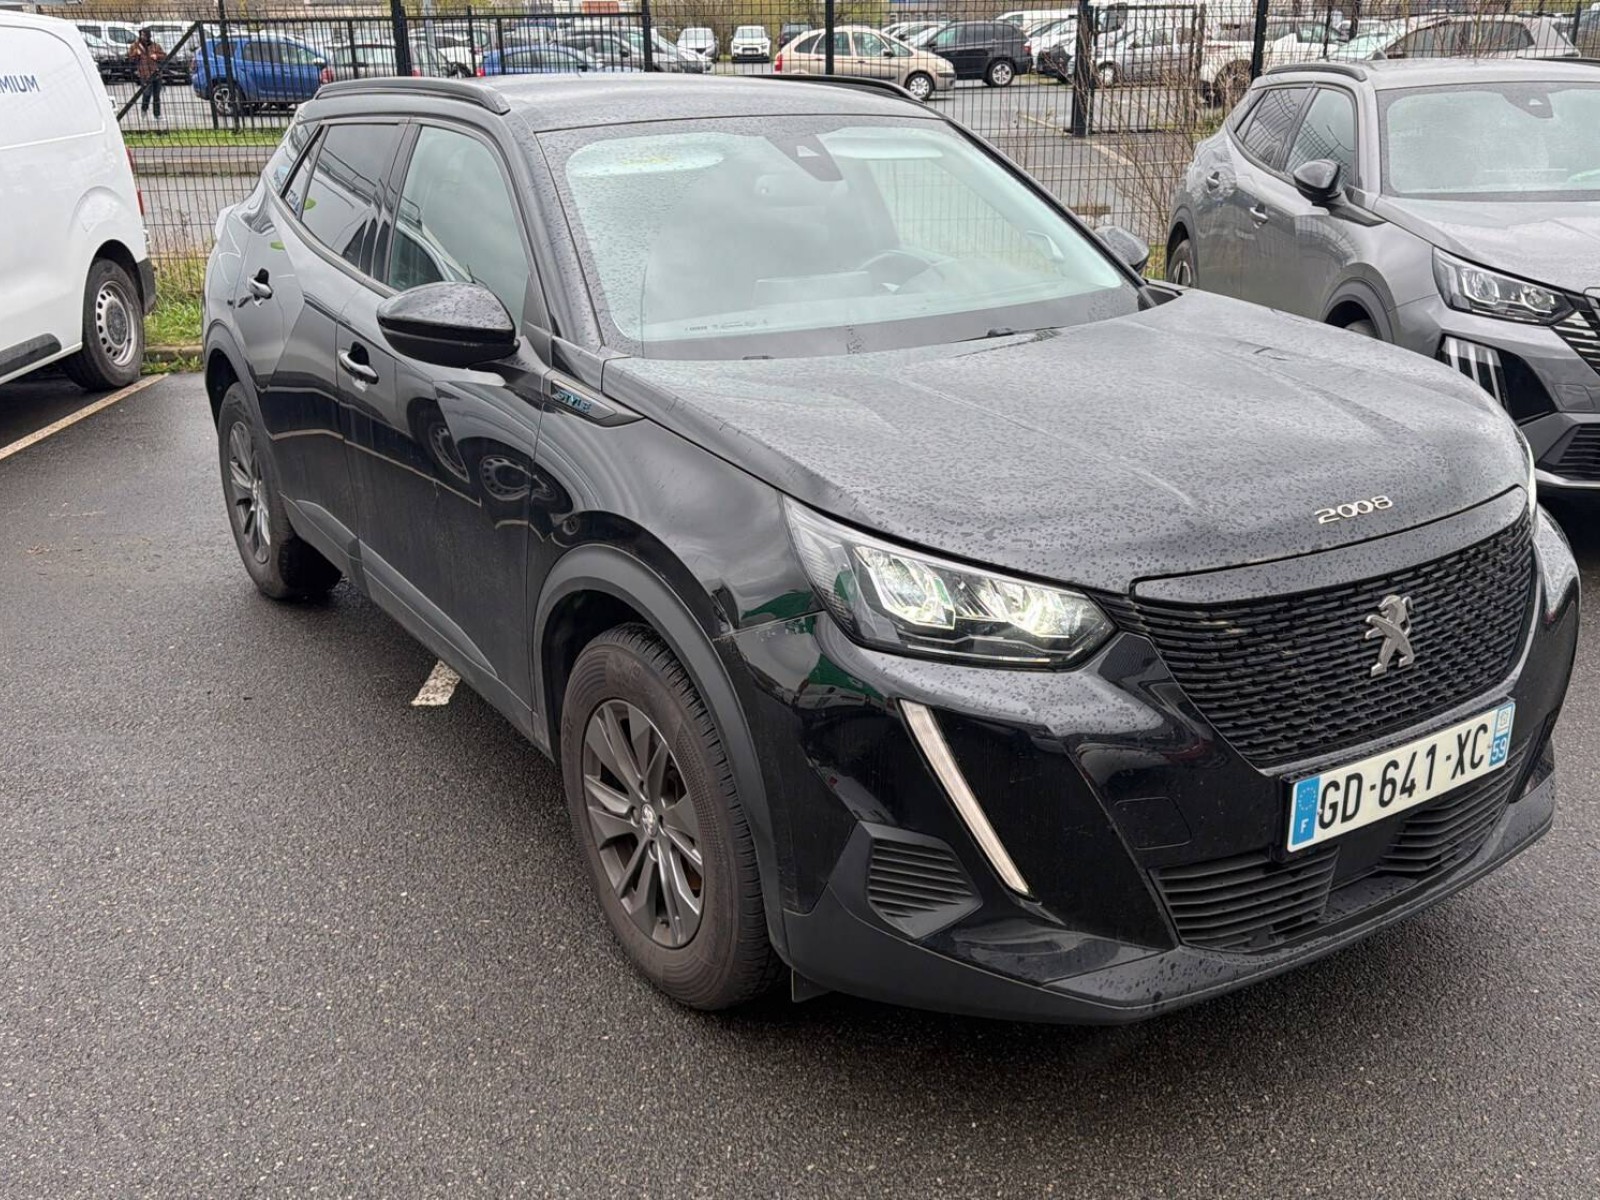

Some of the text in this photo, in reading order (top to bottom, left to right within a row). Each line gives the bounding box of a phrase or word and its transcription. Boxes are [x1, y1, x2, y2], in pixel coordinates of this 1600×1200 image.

[1314, 495, 1393, 524] 2008
[1491, 737, 1507, 761] 59
[1318, 723, 1489, 830] GD-641-XC
[1300, 818, 1310, 834] F
